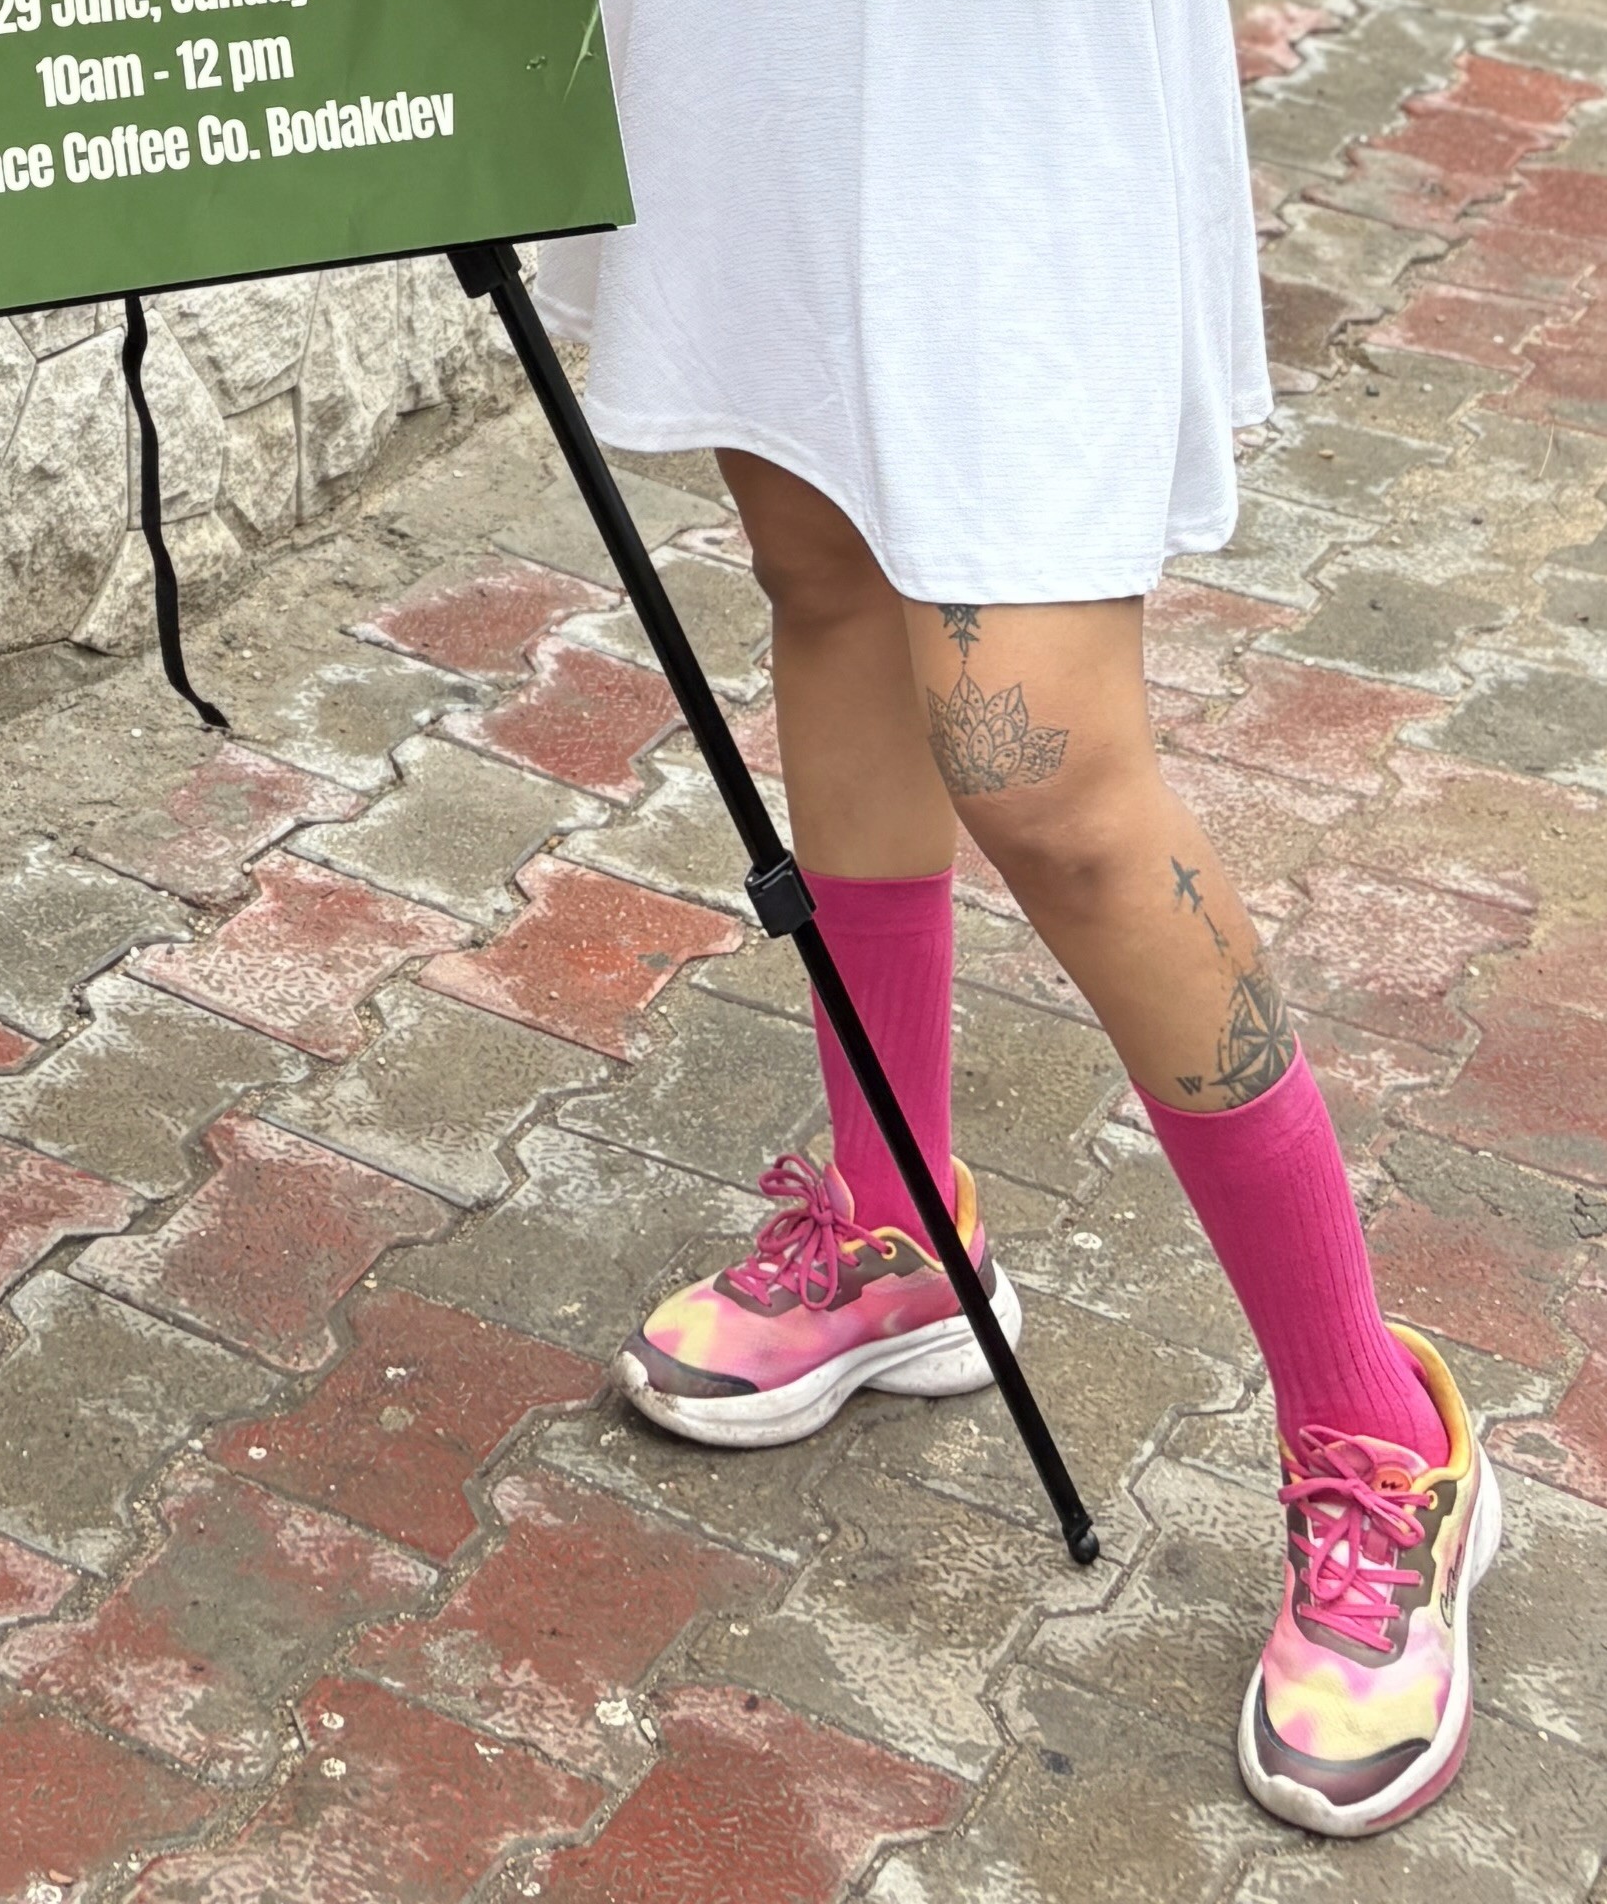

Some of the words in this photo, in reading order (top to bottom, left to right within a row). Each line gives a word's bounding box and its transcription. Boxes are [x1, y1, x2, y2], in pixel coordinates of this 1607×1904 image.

[35, 52, 145, 108] 10am
[153, 70, 169, 80] -
[175, 38, 223, 90] 12
[228, 35, 295, 93] pm
[62, 126, 191, 183] Coffee
[197, 114, 261, 166] Co.
[265, 93, 455, 157] Bodakdev
